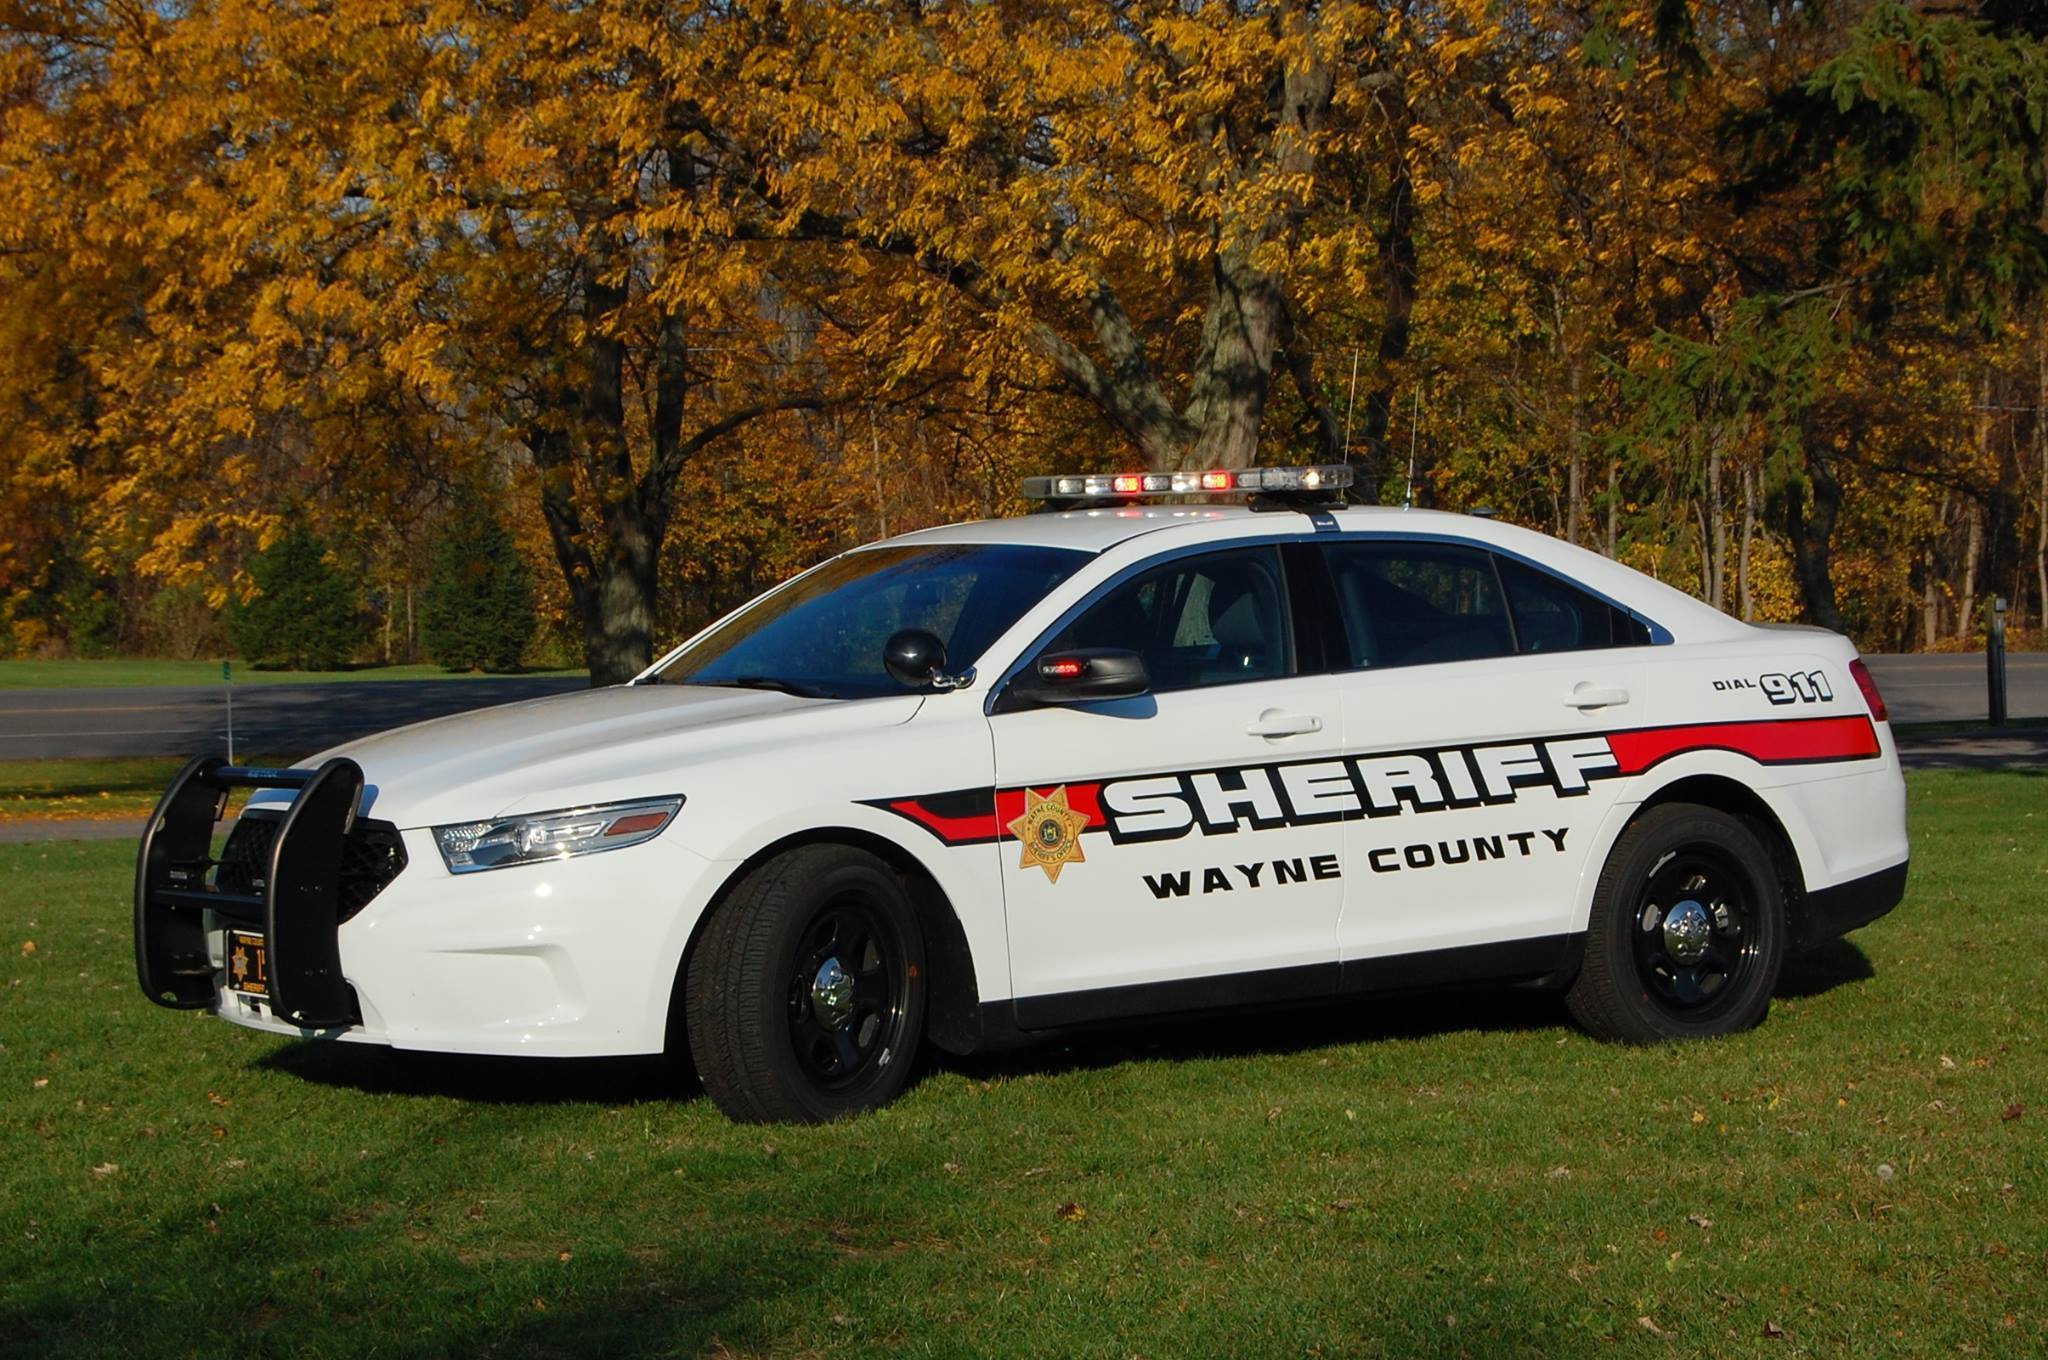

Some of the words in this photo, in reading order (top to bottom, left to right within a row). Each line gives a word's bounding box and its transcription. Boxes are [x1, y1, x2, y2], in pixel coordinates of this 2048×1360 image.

[1712, 678, 1757, 691] DIAL
[1759, 670, 1834, 706] 911
[1103, 735, 1619, 844] SHERIFF
[1143, 853, 1342, 900] WAYNE
[1367, 827, 1570, 875] COUNTY
